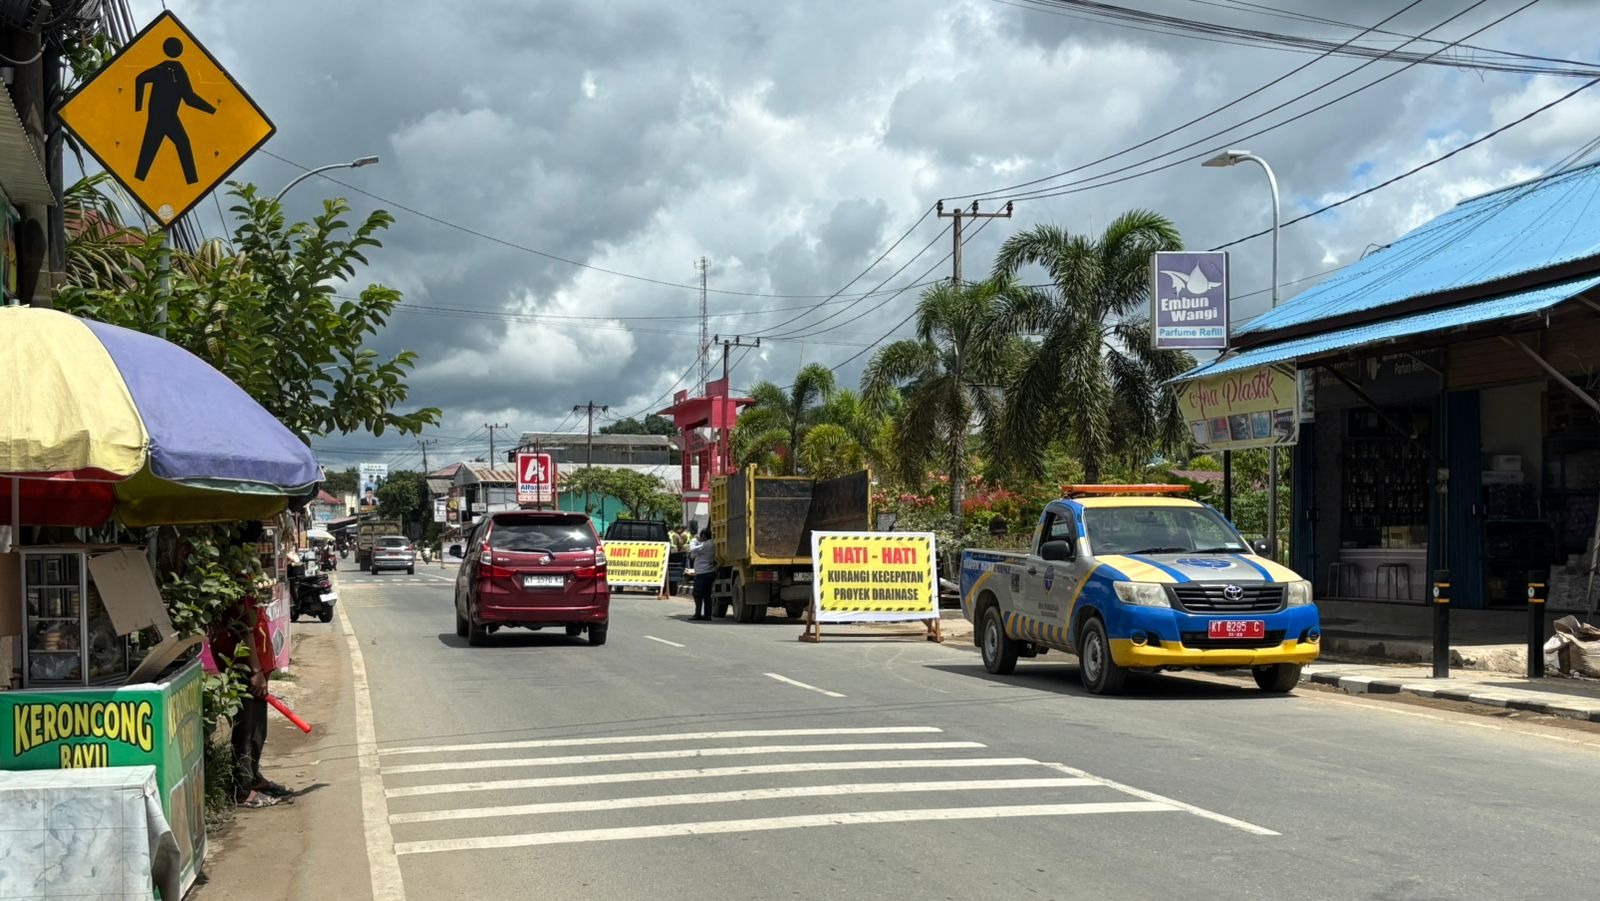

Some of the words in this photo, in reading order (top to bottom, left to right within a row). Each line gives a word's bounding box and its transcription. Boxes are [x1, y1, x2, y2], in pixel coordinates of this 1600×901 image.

[1161, 297, 1209, 311] Embun
[1171, 307, 1217, 322] Wangi
[1160, 328, 1197, 336] Parfume
[1200, 328, 1223, 336] Refill
[1223, 368, 1279, 411] Plastik
[610, 547, 631, 557] HATI
[638, 548, 658, 558] HATI
[833, 547, 868, 564] HATI
[881, 548, 917, 564] HATI
[828, 570, 869, 582] KURANGI
[872, 571, 923, 583] KECEPATAN
[834, 588, 870, 600] PROYEK
[873, 589, 919, 600] DRAINASE
[1212, 622, 1221, 632] KT
[1226, 621, 1247, 632] 8295
[1254, 621, 1260, 632] C
[14, 701, 153, 755] KERONCONG
